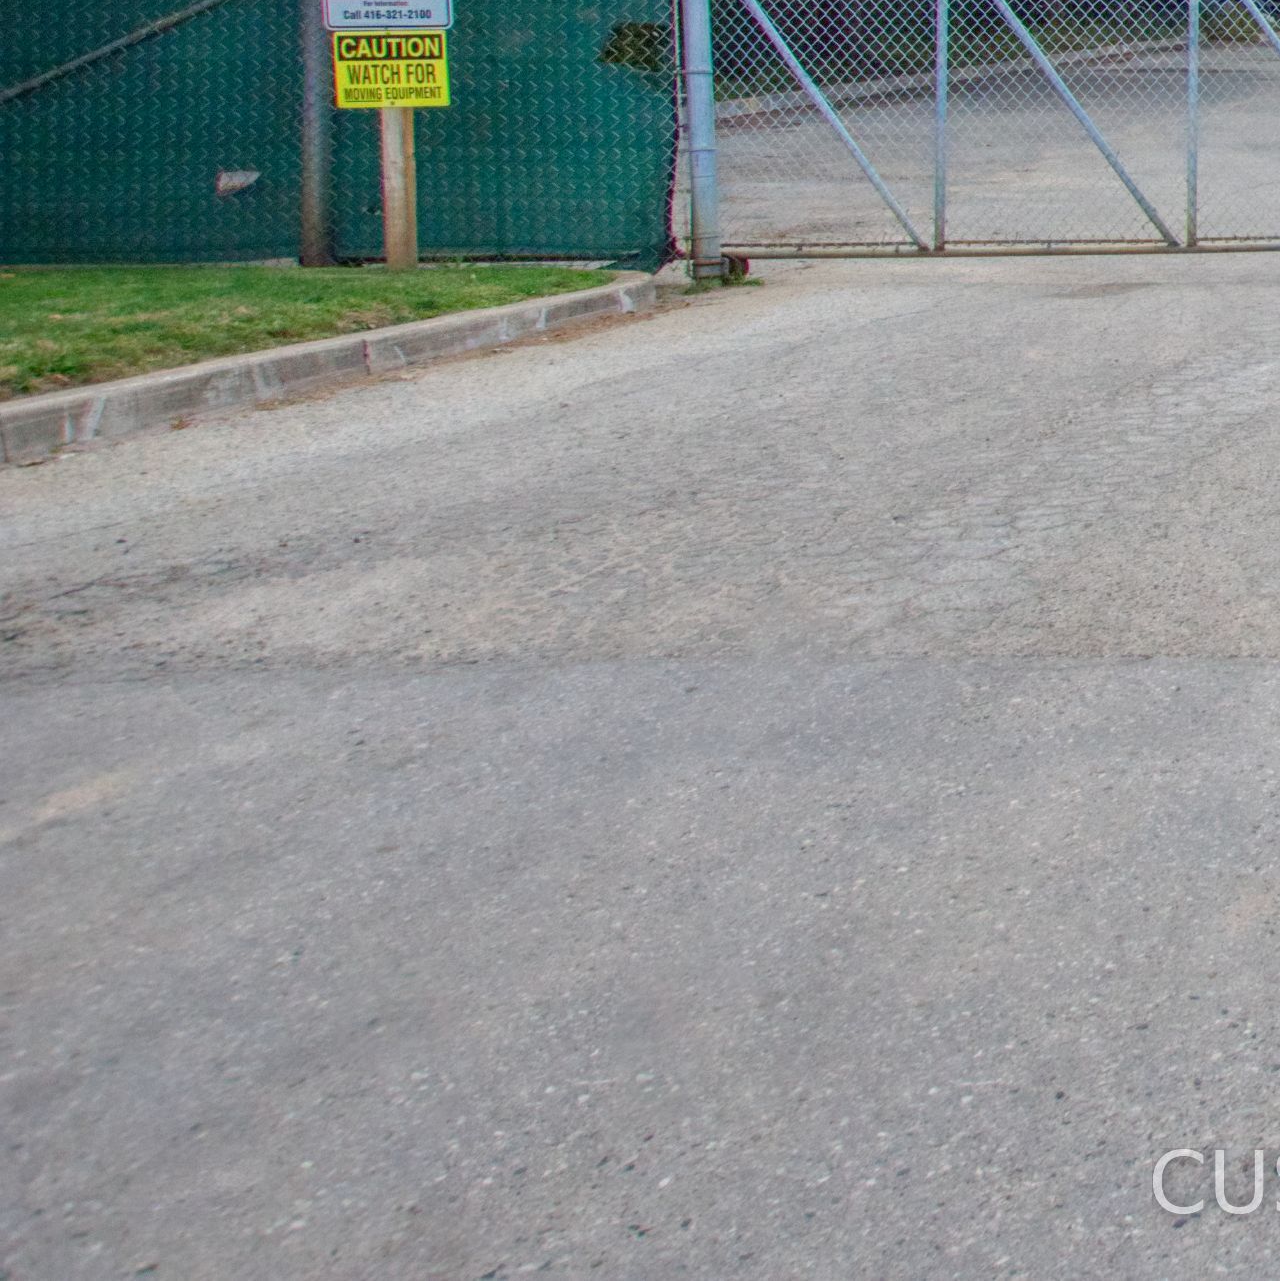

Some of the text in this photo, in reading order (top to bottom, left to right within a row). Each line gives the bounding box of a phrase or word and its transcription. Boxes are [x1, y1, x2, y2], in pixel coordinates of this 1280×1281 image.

[343, 9, 432, 20] Call 416-321-2100
[341, 37, 440, 58] CAUTION
[346, 63, 437, 85] WATCH FOR
[344, 86, 441, 100] MOVING EQUIPMENT
